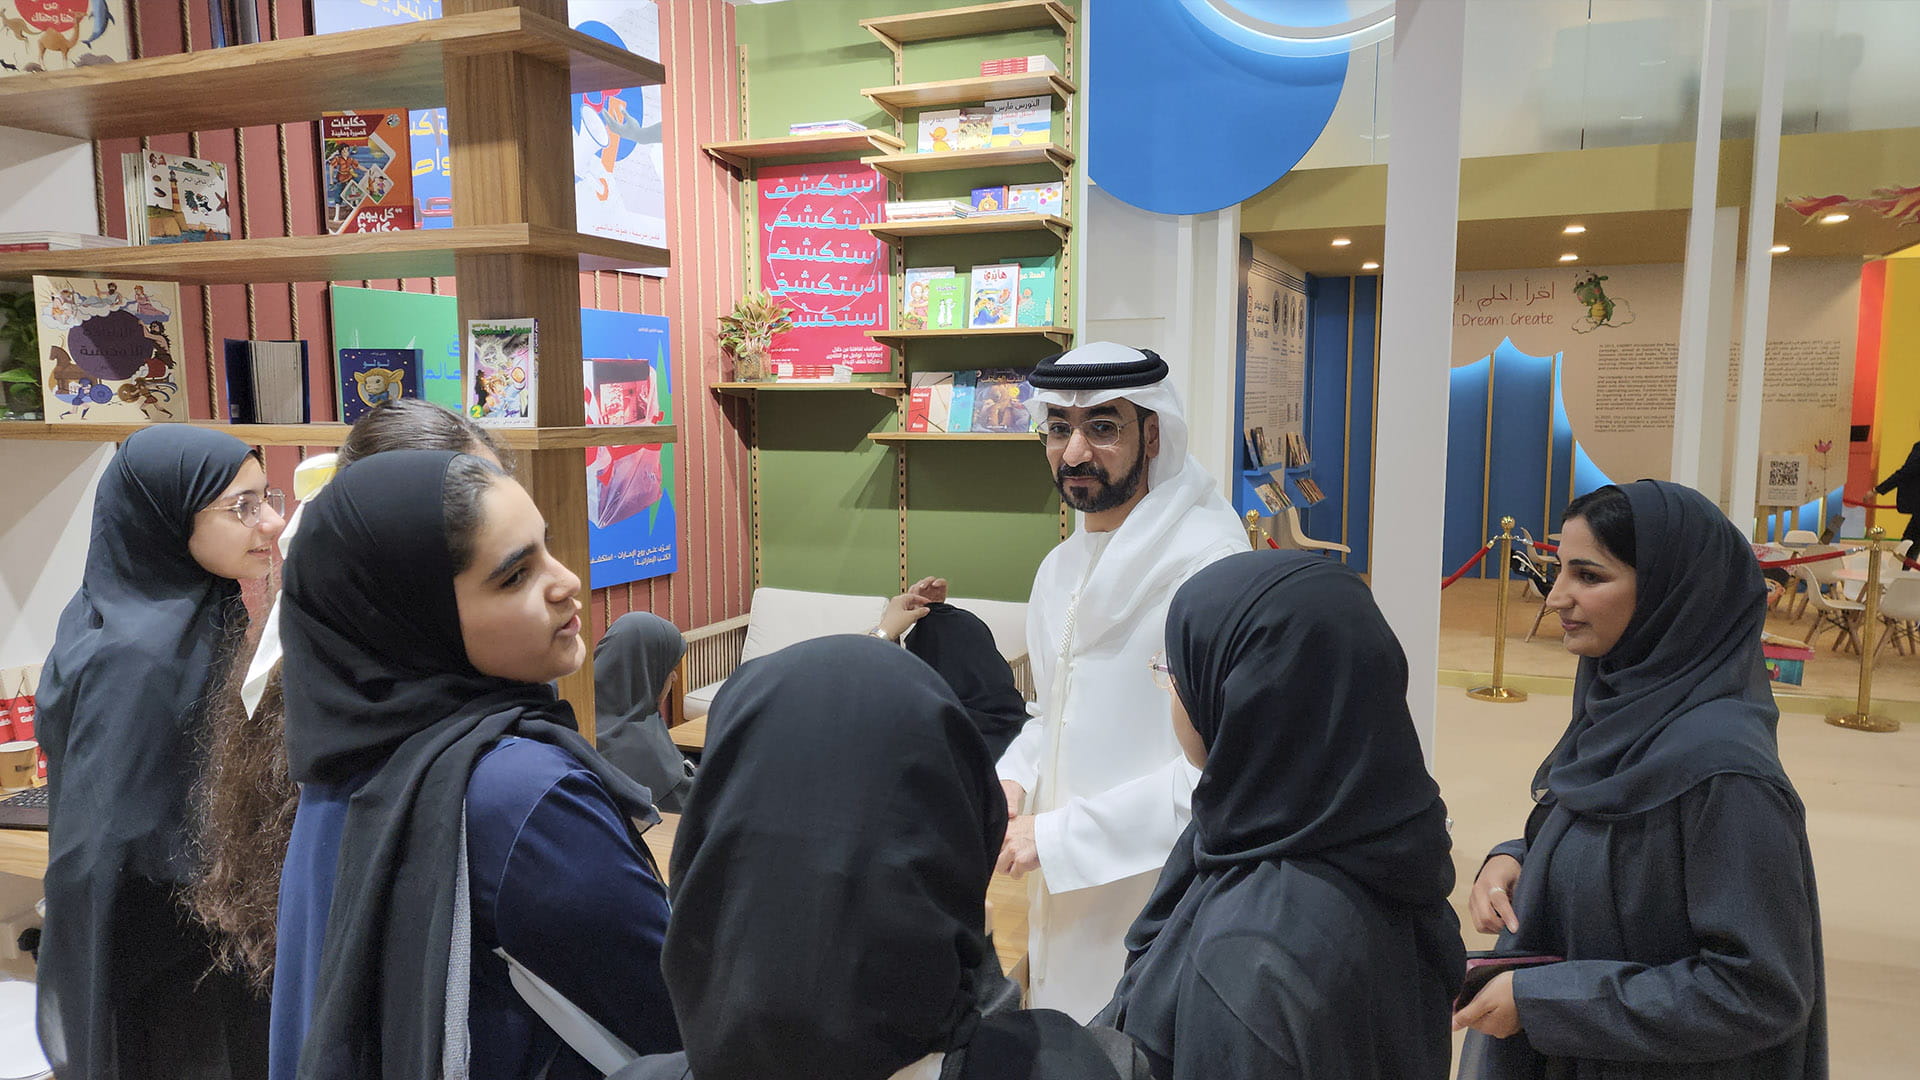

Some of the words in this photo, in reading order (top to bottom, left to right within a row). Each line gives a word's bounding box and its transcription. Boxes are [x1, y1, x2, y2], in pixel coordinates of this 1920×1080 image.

[1015, 99, 1040, 110] النورس
[331, 116, 367, 130] حكايات
[765, 171, 880, 199] استكشف
[357, 210, 379, 226] يوم
[767, 237, 881, 264] استكشف
[767, 270, 882, 297] استكشف
[1526, 276, 1555, 306] اقرأ
[1477, 282, 1513, 312] احلم
[1461, 313, 1504, 326] Dream
[1510, 312, 1554, 325] Create
[471, 406, 482, 418] 2
